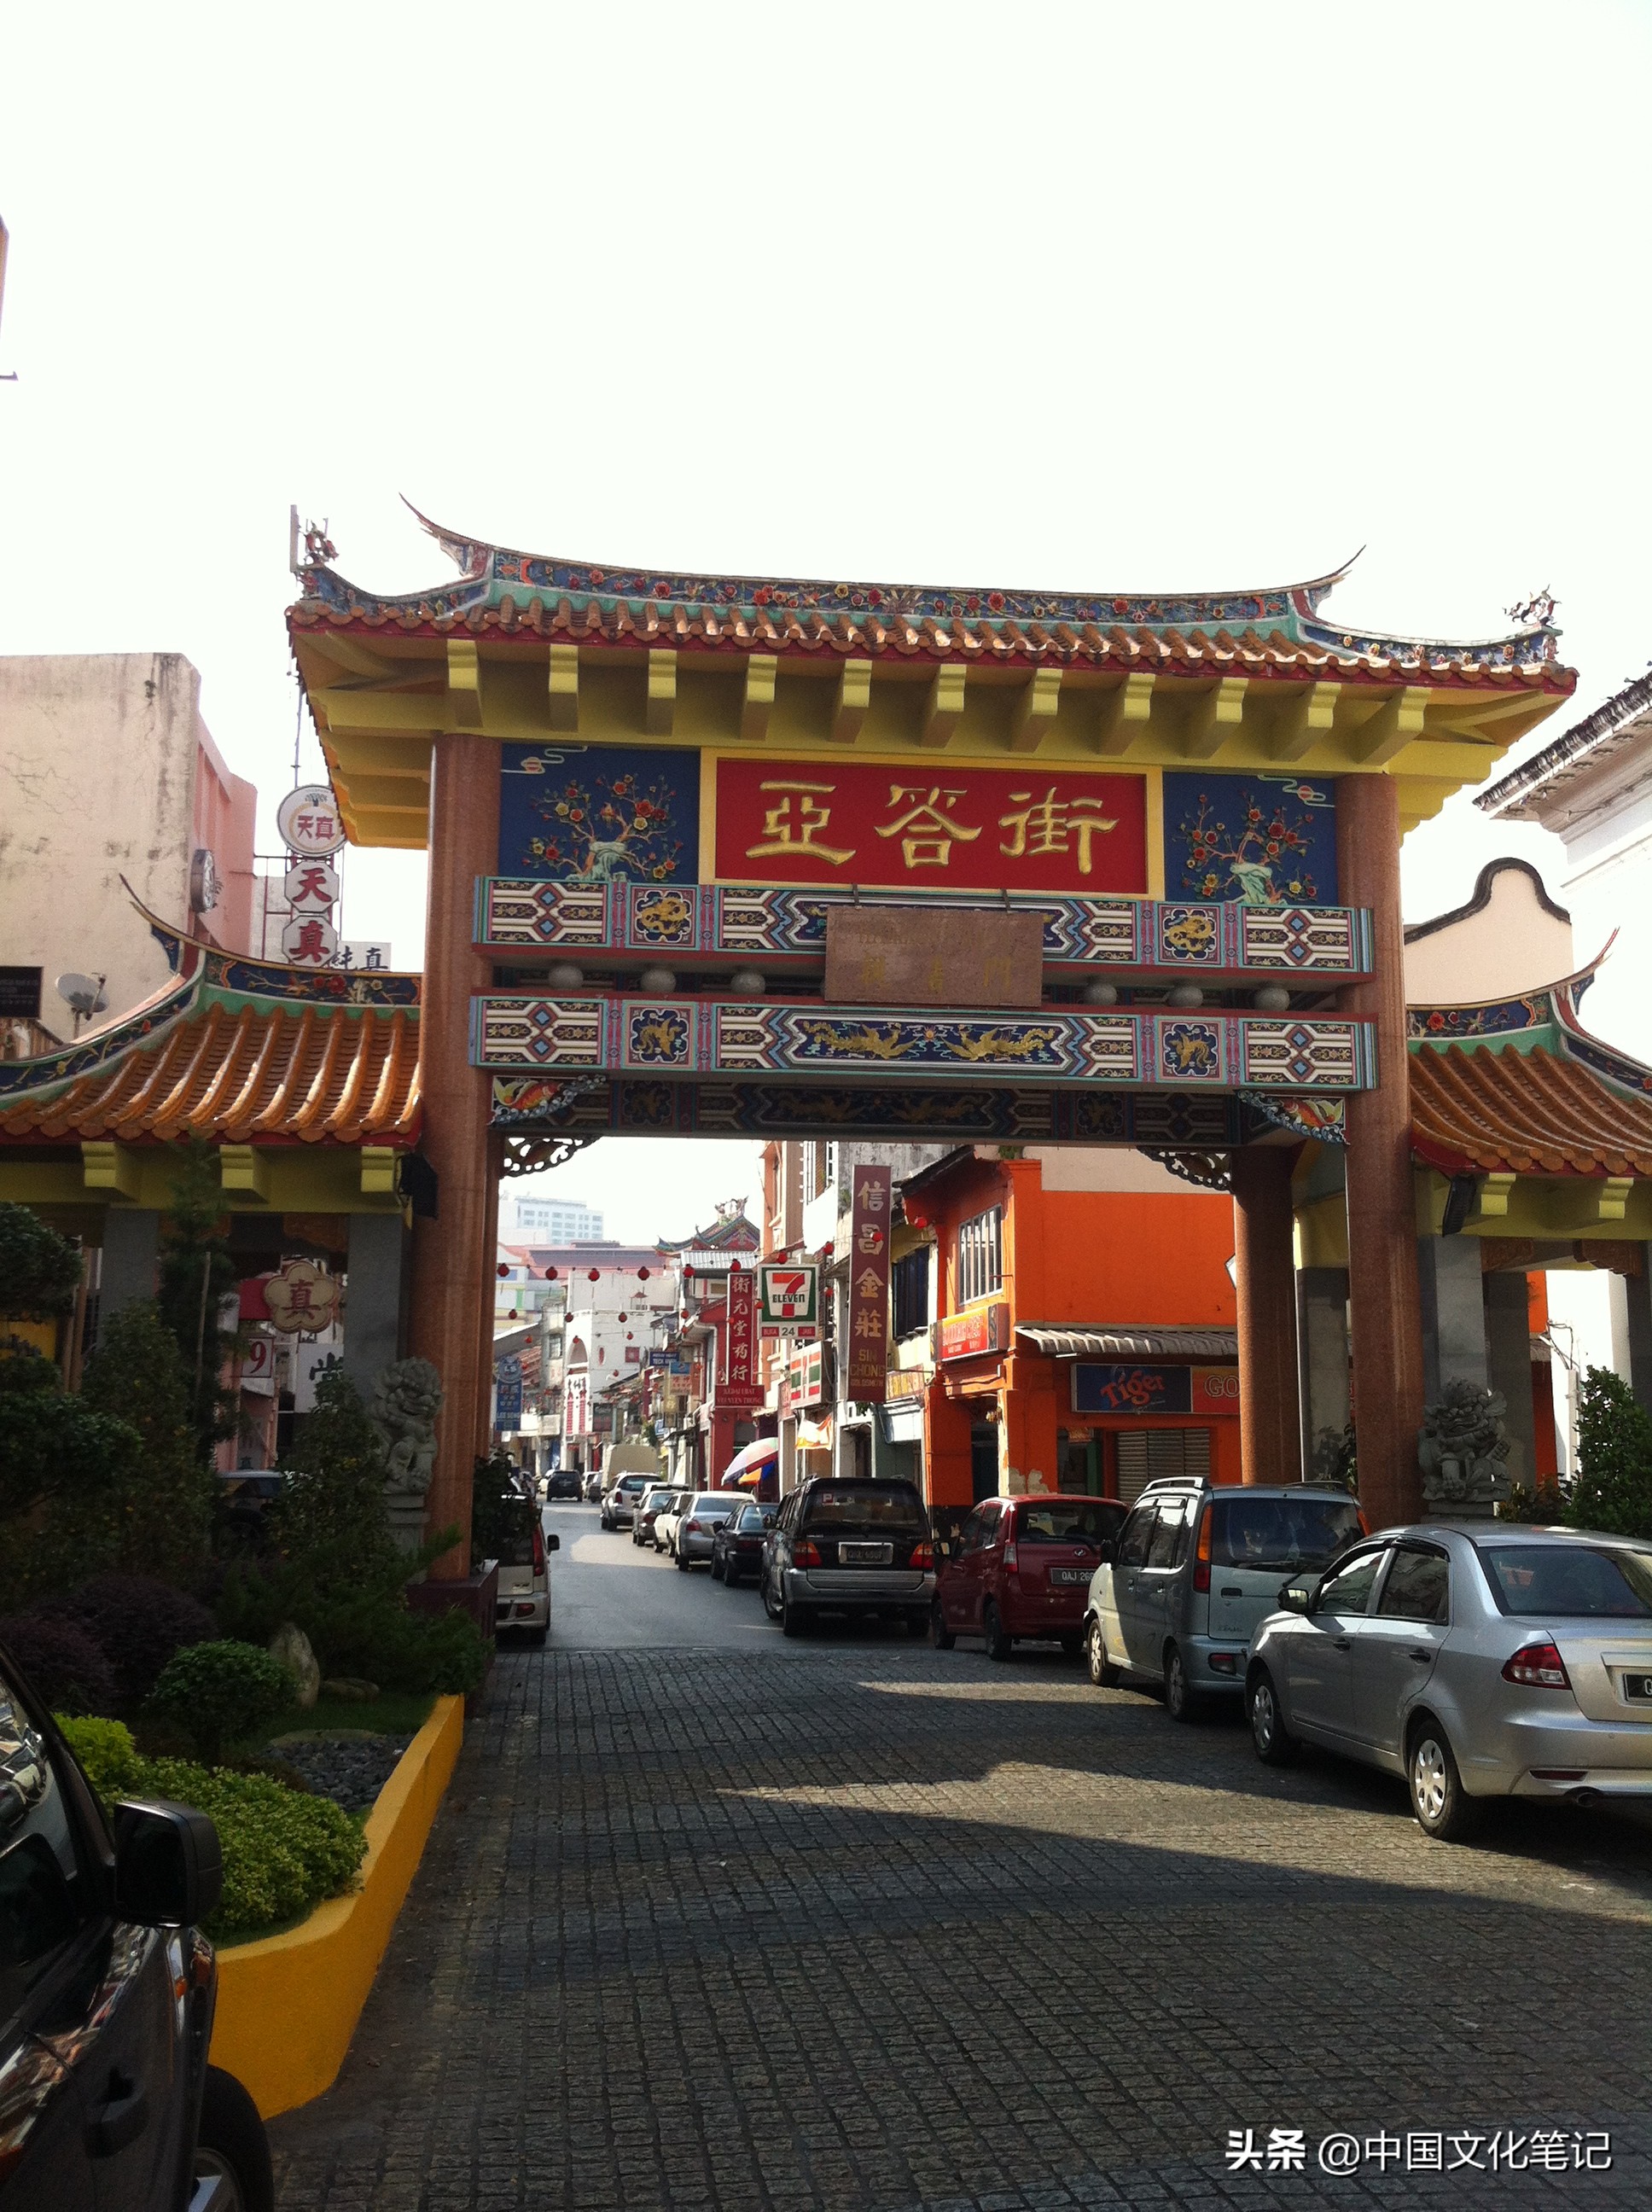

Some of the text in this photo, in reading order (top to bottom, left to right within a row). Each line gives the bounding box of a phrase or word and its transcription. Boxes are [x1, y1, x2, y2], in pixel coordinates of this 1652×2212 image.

[298, 815, 335, 840] 天真
[746, 780, 1120, 875] 亞答街
[289, 867, 333, 963] 天真
[282, 1281, 322, 1320] 真
[782, 1327, 795, 1336] 24
[249, 1341, 267, 1374] 9
[1101, 1370, 1166, 1408] Tiger
